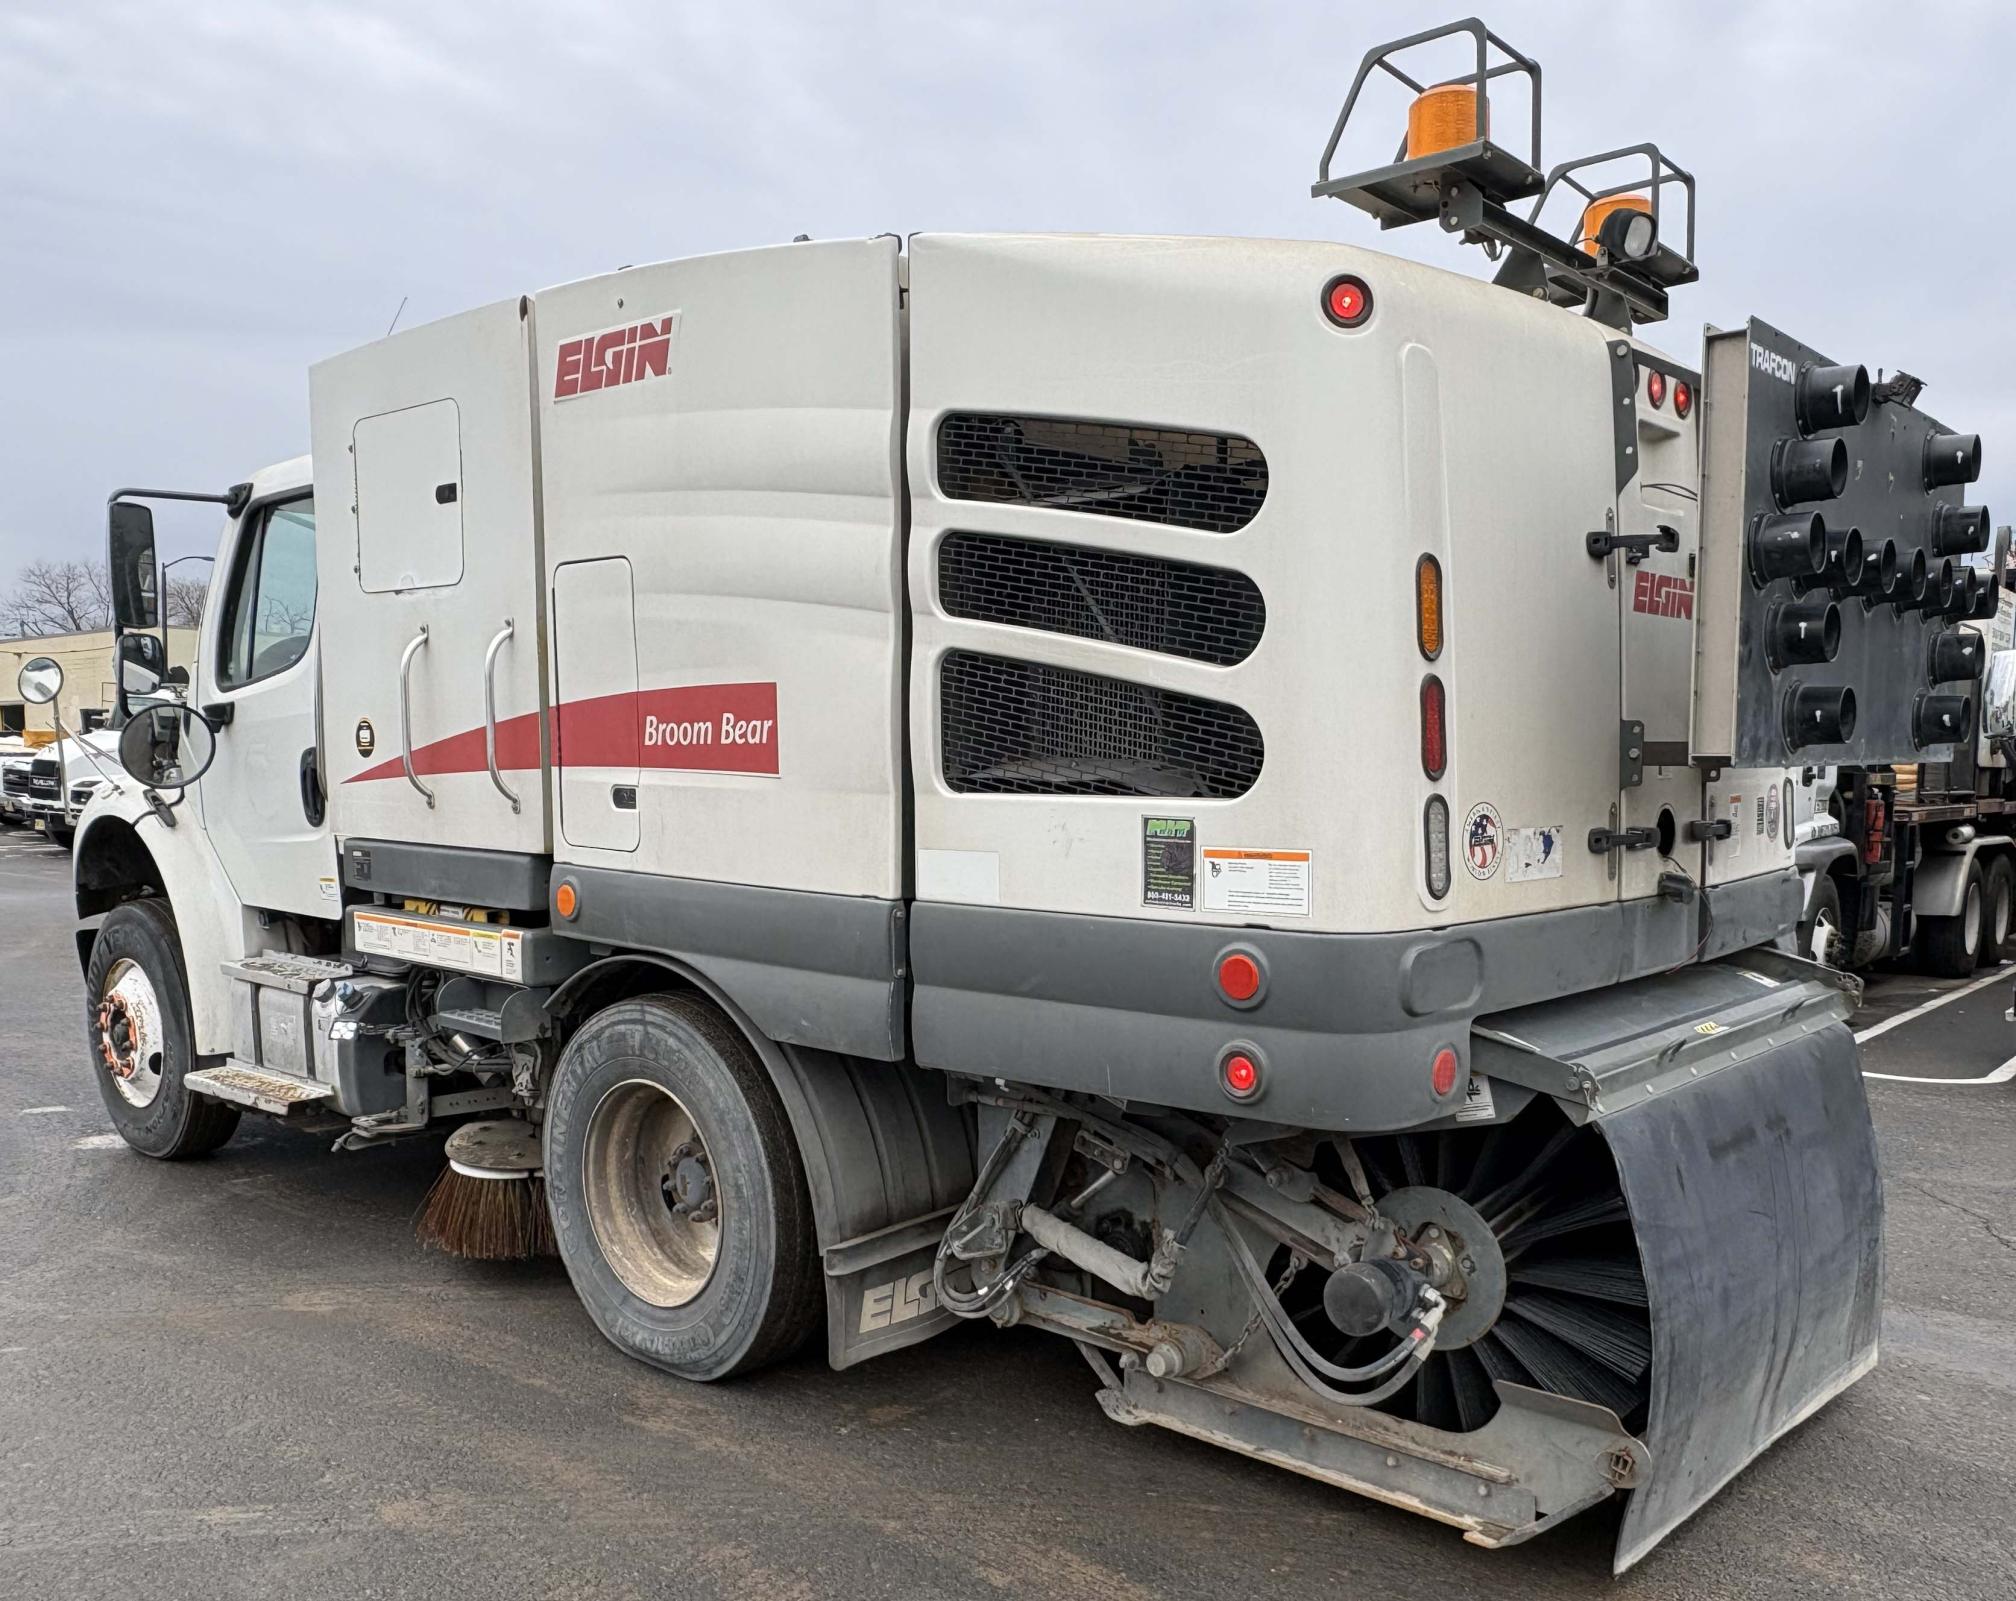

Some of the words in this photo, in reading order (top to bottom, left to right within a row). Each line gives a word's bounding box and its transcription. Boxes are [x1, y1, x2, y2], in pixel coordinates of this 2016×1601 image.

[554, 316, 673, 399] ELGIN
[1750, 341, 1796, 385] TRAFCON
[1633, 570, 1695, 620] ELGIN
[644, 715, 713, 746] Broom
[720, 712, 773, 745] Bear
[859, 1267, 945, 1334] ELG
